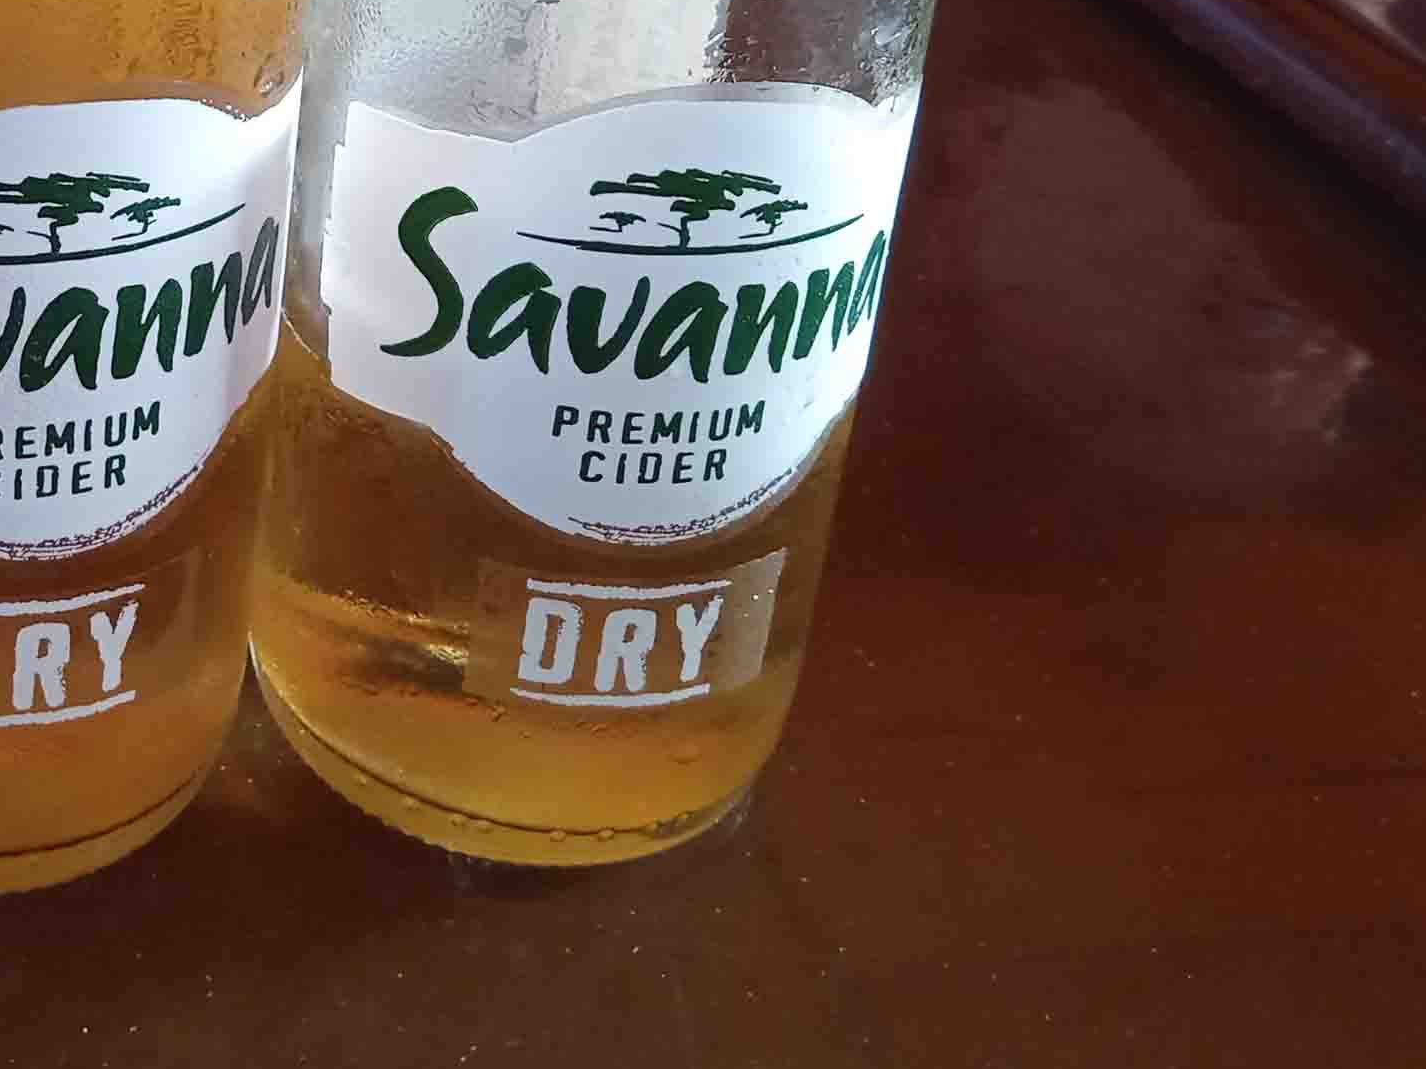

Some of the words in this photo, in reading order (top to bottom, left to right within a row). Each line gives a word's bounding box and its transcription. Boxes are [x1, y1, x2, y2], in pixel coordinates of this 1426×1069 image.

[382, 186, 885, 383] Savanna
[552, 400, 765, 444] PREMIUM
[579, 448, 728, 484] CIDER
[518, 595, 724, 692] DRY
